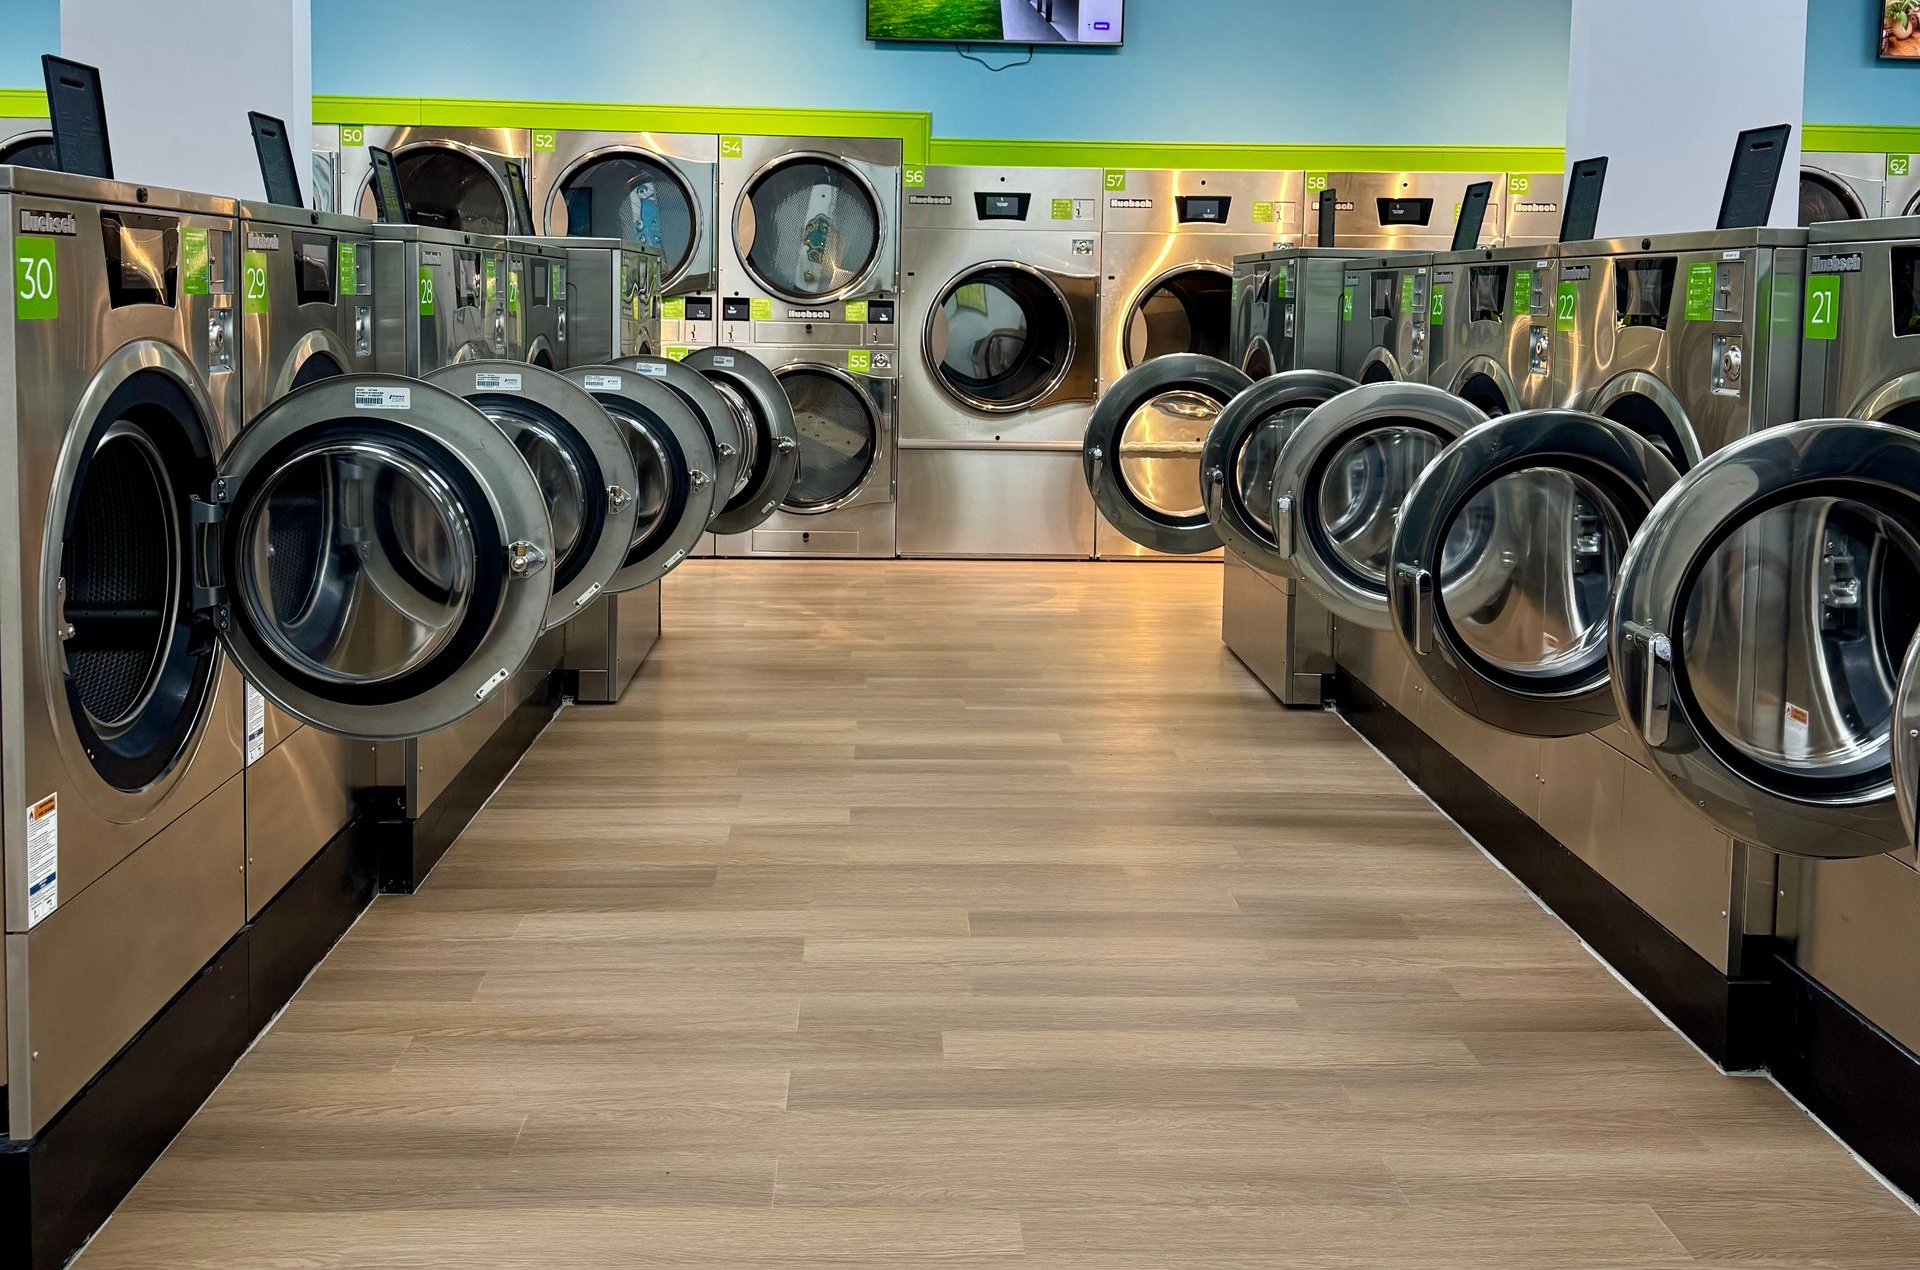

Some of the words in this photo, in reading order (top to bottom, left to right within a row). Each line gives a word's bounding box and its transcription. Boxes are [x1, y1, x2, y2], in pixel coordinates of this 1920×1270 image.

[343, 129, 363, 142] 50
[535, 134, 553, 148] 52
[722, 141, 741, 154] 54
[1890, 159, 1907, 171] 62
[905, 170, 923, 183] 56
[1106, 174, 1124, 187] 57
[1307, 177, 1326, 189] 58
[1510, 178, 1528, 191] 59
[20, 257, 53, 300] 30
[247, 267, 266, 299] 29
[421, 279, 433, 304] 28
[1432, 294, 1443, 315] 23
[1559, 294, 1574, 320] 22
[1811, 291, 1832, 324] 21
[788, 310, 830, 318] Huebsch
[850, 355, 867, 368] 55
